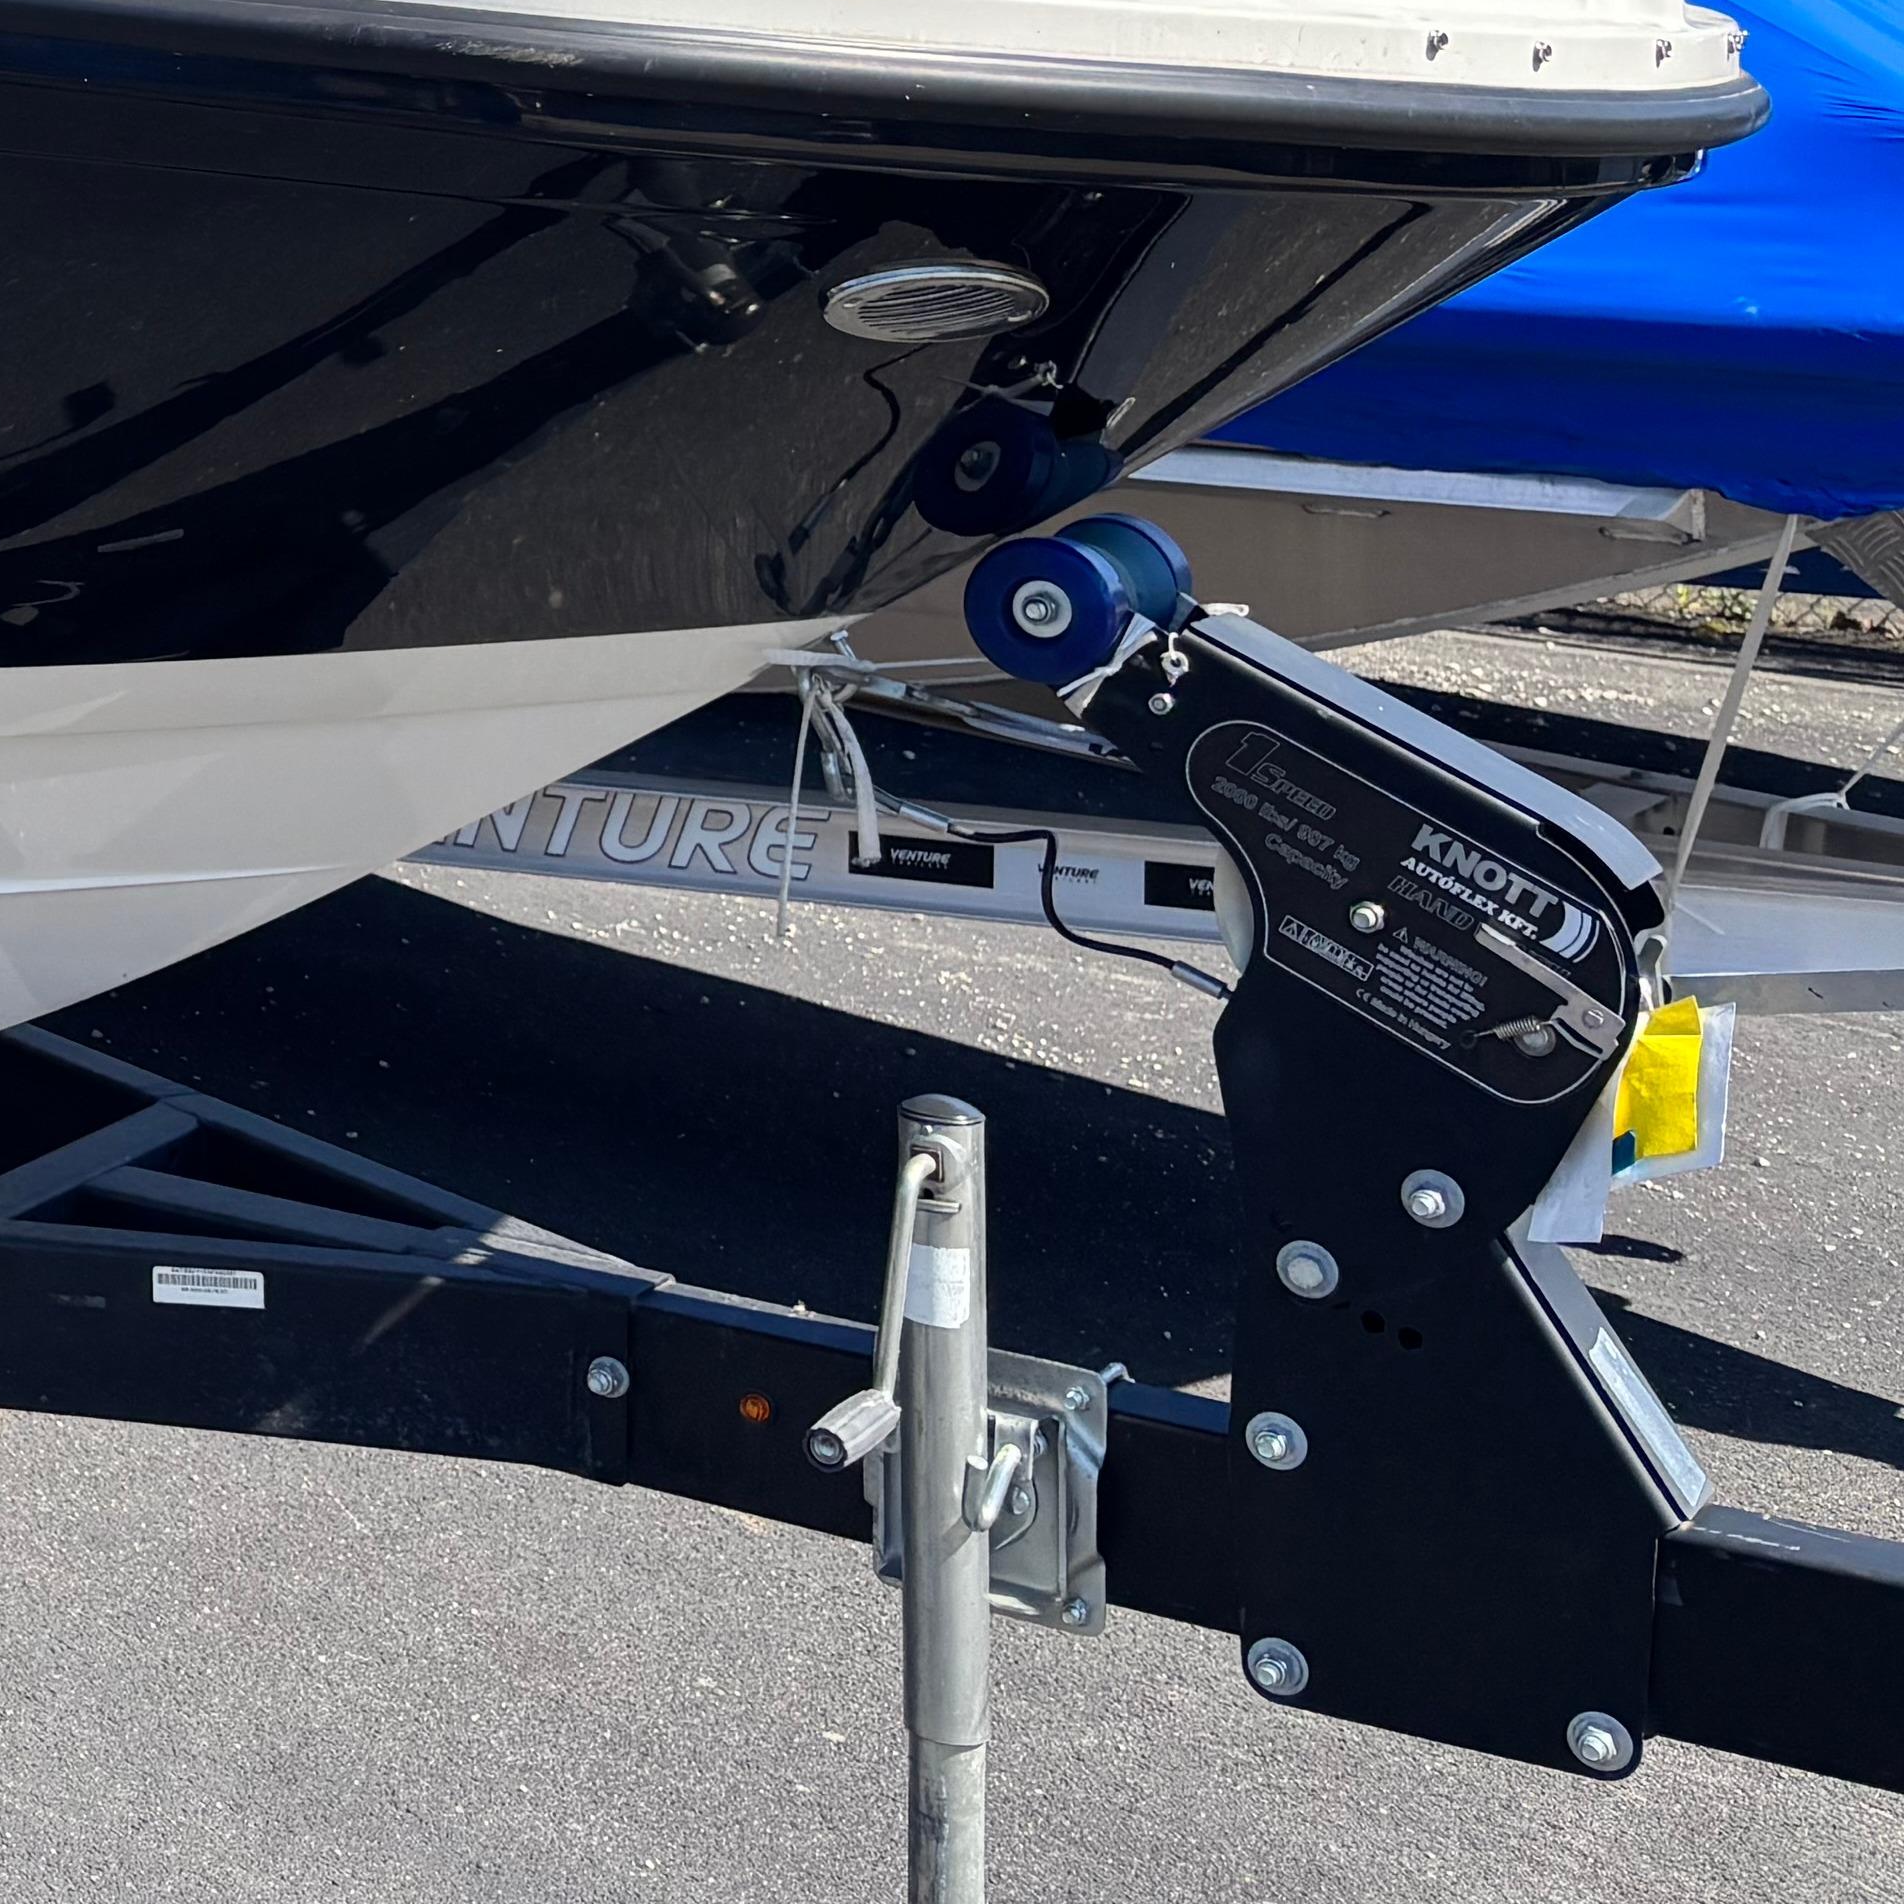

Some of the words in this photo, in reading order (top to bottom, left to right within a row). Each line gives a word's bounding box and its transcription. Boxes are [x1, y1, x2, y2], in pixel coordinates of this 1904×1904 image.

[1210, 776, 1258, 810] 2000
[890, 848, 951, 865] VENTURE
[1037, 863, 1099, 880] VNTURE
[1265, 833, 1349, 890] Capacity
[1411, 824, 1559, 919] KNOTT
[1387, 875, 1475, 931] HAND
[1400, 857, 1500, 916] AUTÓFLEX
[1497, 911, 1543, 940] KFT.
[1413, 936, 1487, 986] WARNING!
